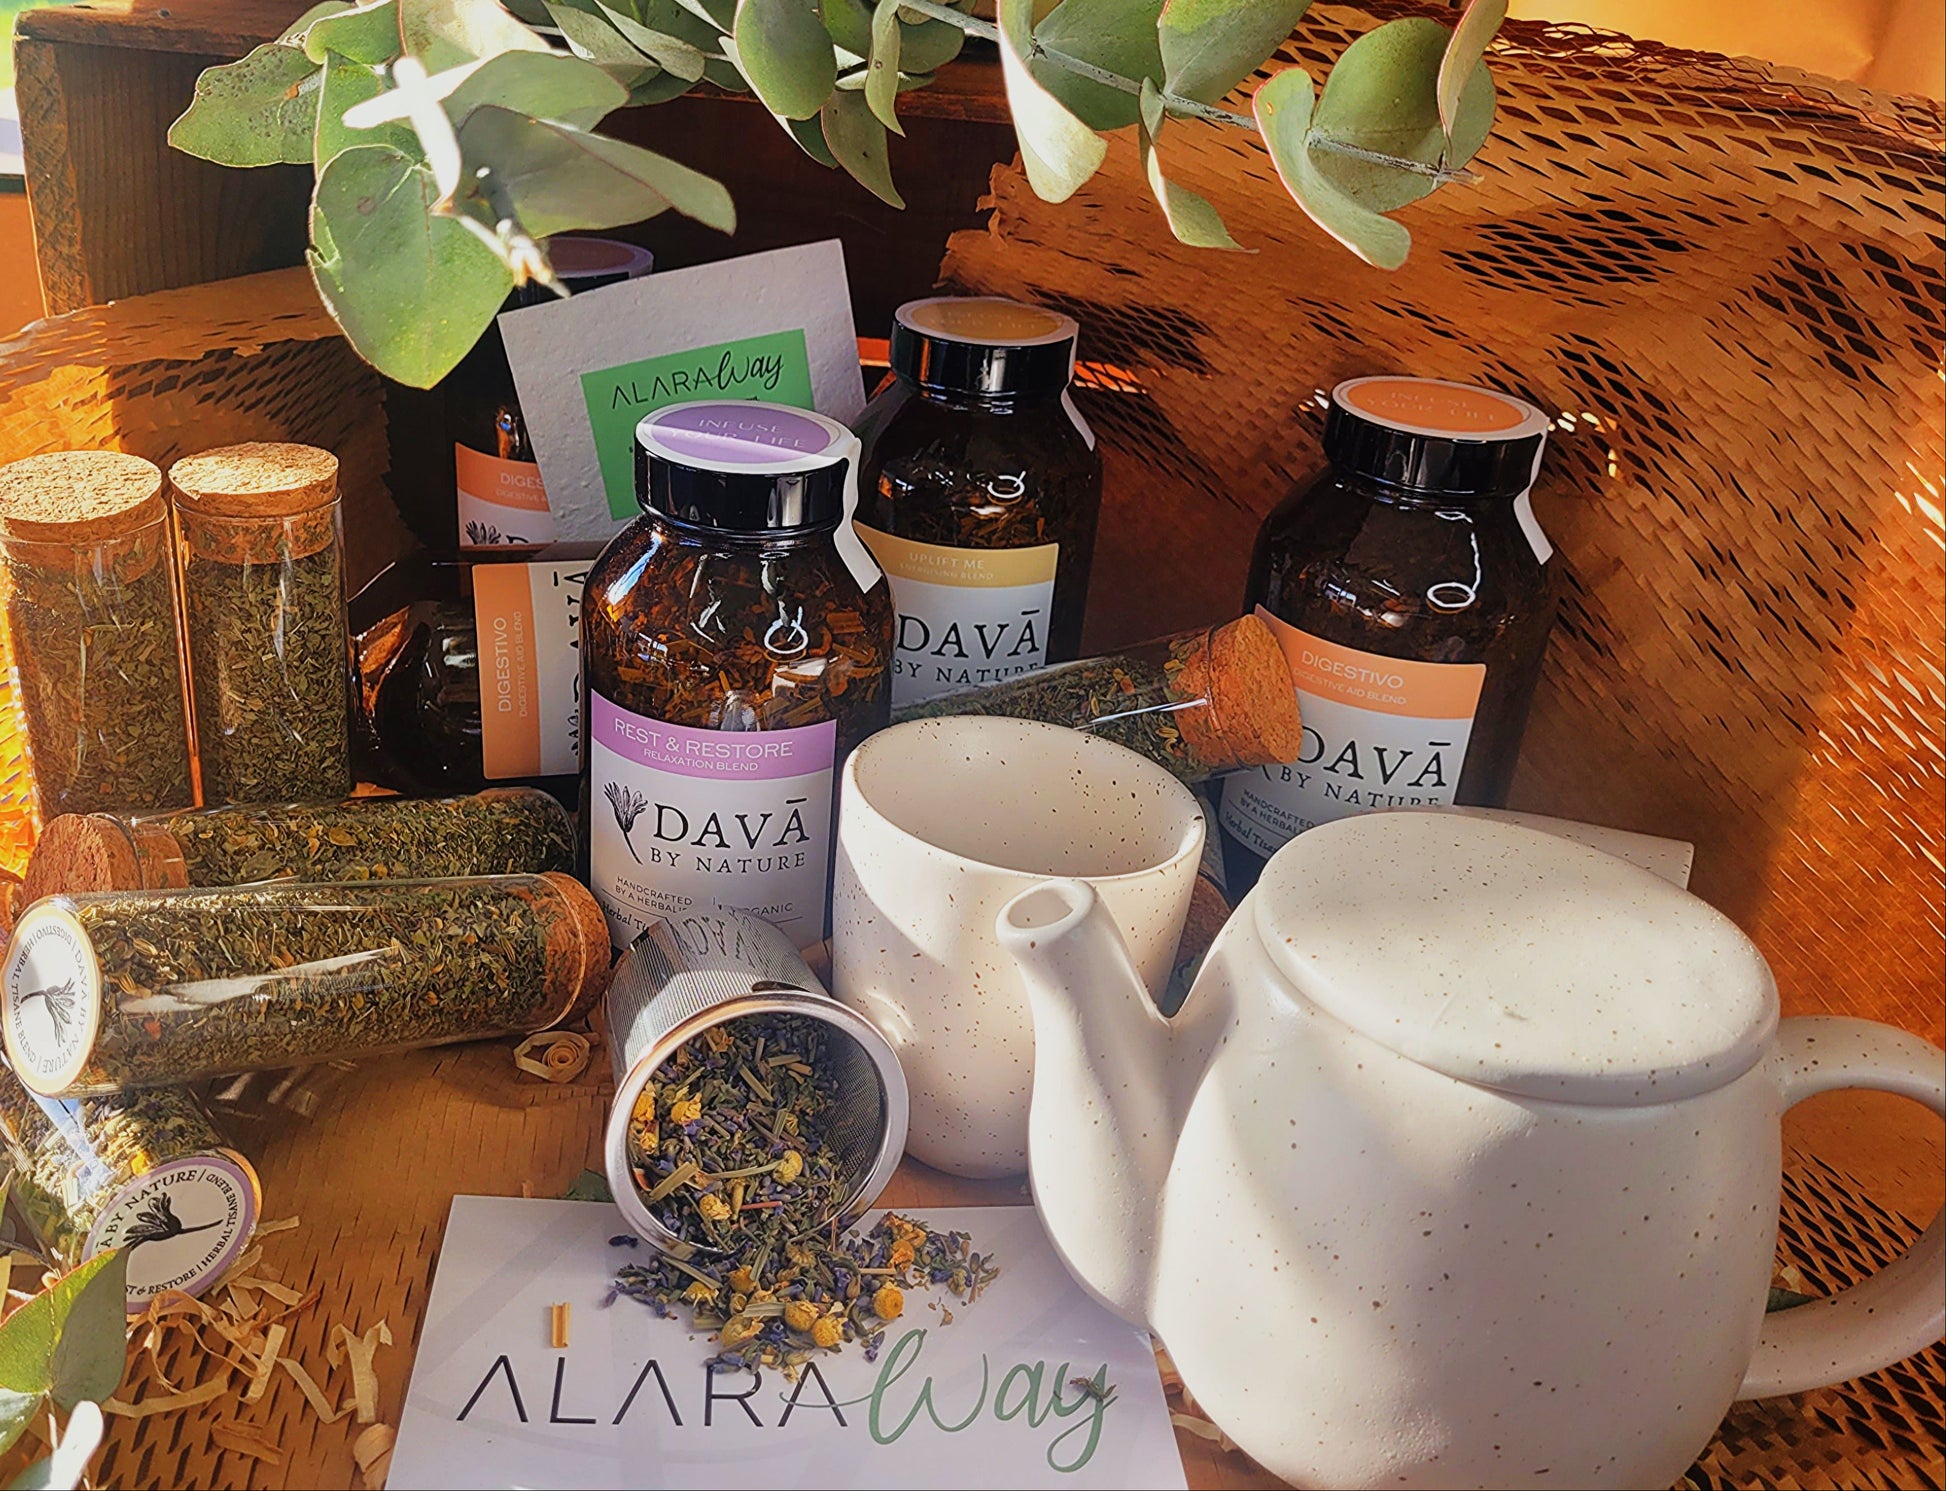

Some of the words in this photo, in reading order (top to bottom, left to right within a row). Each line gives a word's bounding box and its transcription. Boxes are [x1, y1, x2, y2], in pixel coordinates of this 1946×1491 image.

[500, 472, 545, 490] DIGES
[909, 552, 958, 568] UPLIFT
[964, 559, 985, 569] ME
[960, 571, 994, 581] BLEND
[513, 611, 525, 640] BLEND
[493, 617, 512, 713] DIGESTIVO
[516, 643, 525, 663] AID
[1301, 650, 1404, 689] DIGESTIVO
[516, 665, 528, 718] DIGESTIVE
[1292, 667, 1345, 692] DIGESTIVE
[1346, 686, 1366, 697] AID
[1367, 692, 1407, 705] BLEND
[614, 718, 662, 747] REST
[666, 736, 680, 753] &
[686, 740, 793, 759] RESTORE
[644, 748, 713, 770] RELAXATION
[716, 761, 759, 772] BLEND
[1280, 765, 1312, 789] BY
[1244, 788, 1315, 828] HANDCRAFTED
[1251, 806, 1258, 815] A
[650, 847, 681, 868] BY
[695, 852, 806, 874] NATURE
[615, 884, 626, 895] BY
[628, 892, 635, 901] A
[617, 876, 693, 905] HANDCRAFTED
[601, 900, 632, 925] Herbal
[35, 924, 73, 946] DIGESTIVO
[11, 937, 35, 982] HERBAL
[11, 983, 23, 1031] TISANE
[17, 1031, 37, 1064] BLEND
[206, 1173, 234, 1195] BLEND
[105, 1211, 124, 1237] BY
[124, 1169, 198, 1211] NATURE
[226, 1195, 238, 1228] TISANE
[201, 1227, 234, 1267] HERBAL
[147, 1268, 198, 1295] RESTORE
